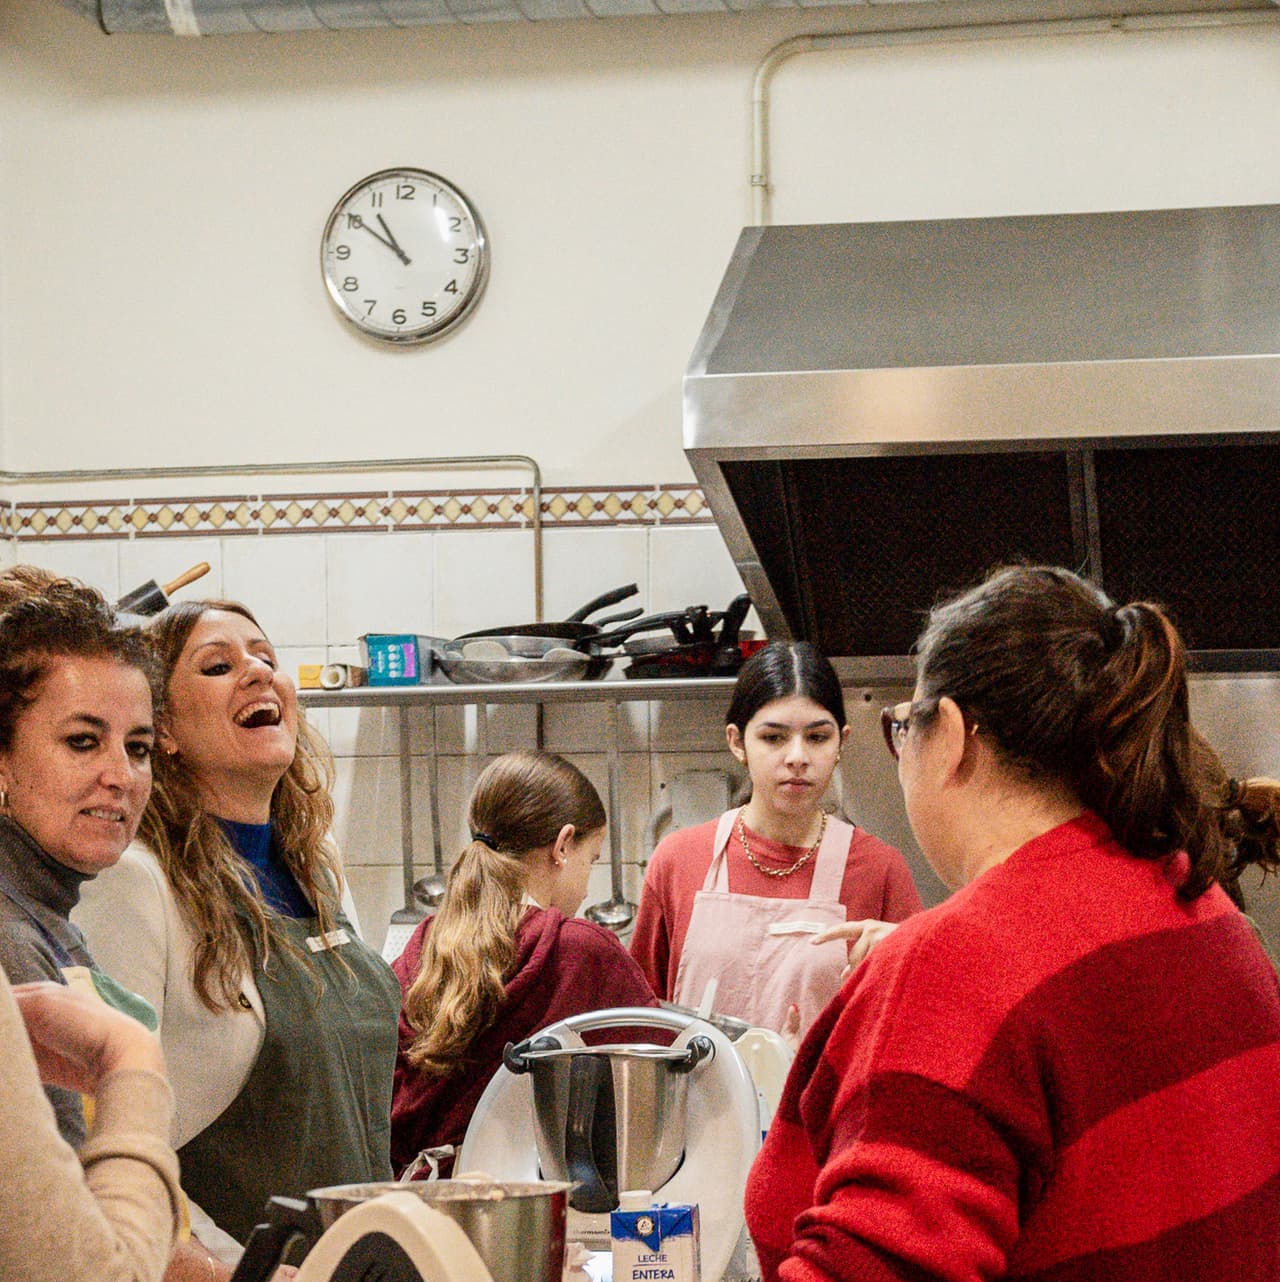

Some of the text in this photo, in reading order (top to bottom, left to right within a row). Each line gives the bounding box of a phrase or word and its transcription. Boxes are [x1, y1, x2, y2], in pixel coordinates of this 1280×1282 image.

[371, 191, 384, 208] 11
[396, 184, 416, 201] 12
[432, 193, 437, 207] 1
[346, 213, 363, 229] 10
[448, 216, 462, 233] 2
[335, 244, 351, 261] 9
[453, 248, 469, 264] 3
[342, 276, 360, 292] 8
[443, 278, 459, 295] 4
[363, 300, 377, 316] 7
[421, 301, 438, 317] 5
[392, 308, 407, 325] 6
[637, 1254, 668, 1263] LECHE
[632, 1269, 675, 1281] ENTERA
